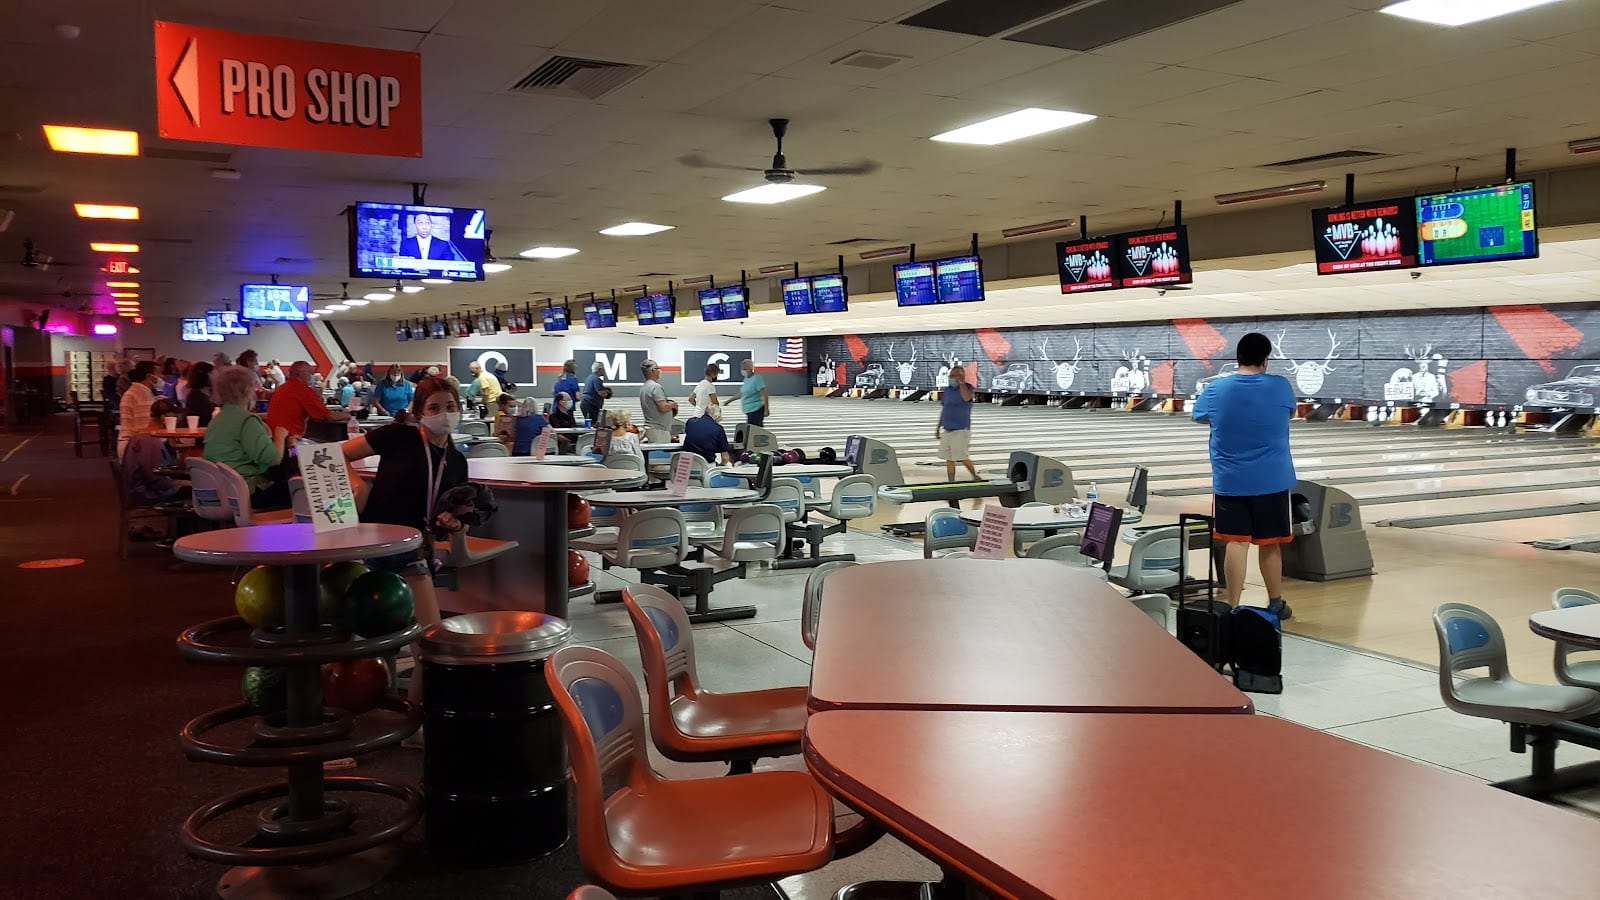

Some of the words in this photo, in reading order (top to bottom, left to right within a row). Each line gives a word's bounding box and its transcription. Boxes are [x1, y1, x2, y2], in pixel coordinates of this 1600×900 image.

[220, 58, 297, 120] PRO
[305, 68, 401, 128] SHOP
[1332, 222, 1354, 240] MVB
[595, 352, 627, 380] M
[707, 353, 731, 380] G
[304, 464, 325, 513] MAINTAIN
